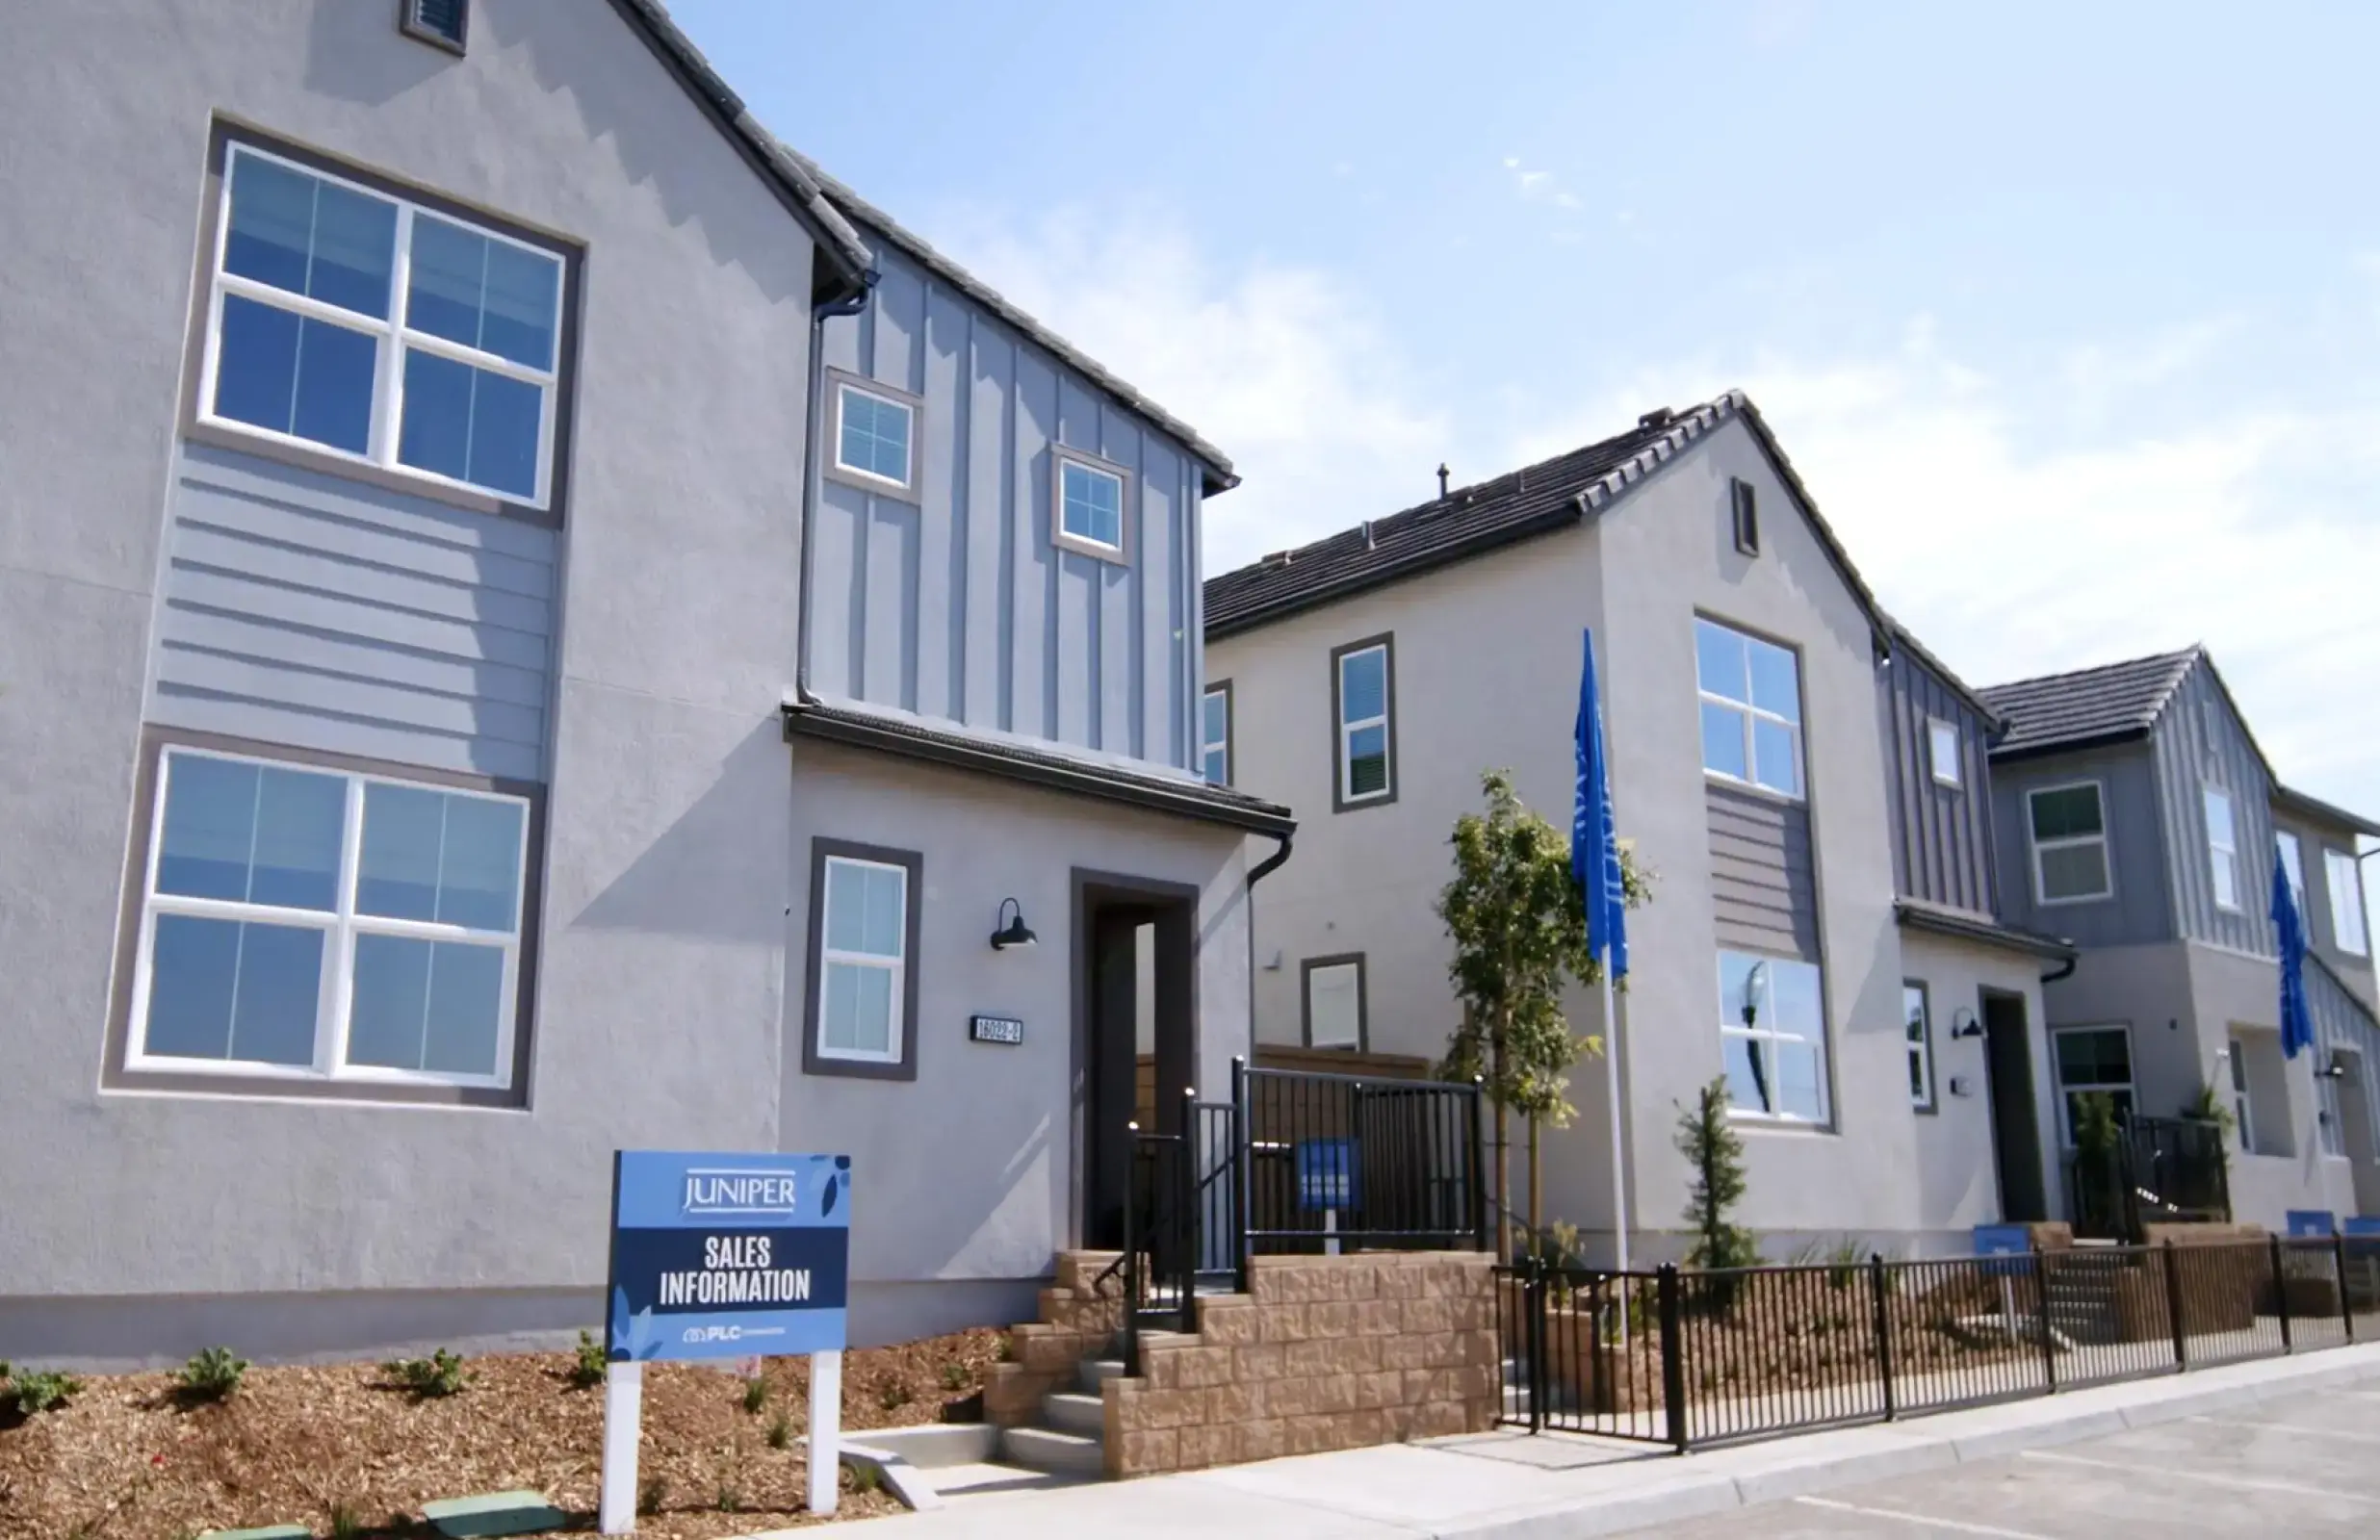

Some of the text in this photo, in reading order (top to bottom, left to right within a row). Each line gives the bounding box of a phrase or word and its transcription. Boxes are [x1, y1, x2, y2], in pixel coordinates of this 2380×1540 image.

[684, 1176, 795, 1209] JUNIPER
[705, 1236, 771, 1270] SALES
[660, 1270, 810, 1305] INFORMATION
[708, 1324, 742, 1341] PLC
